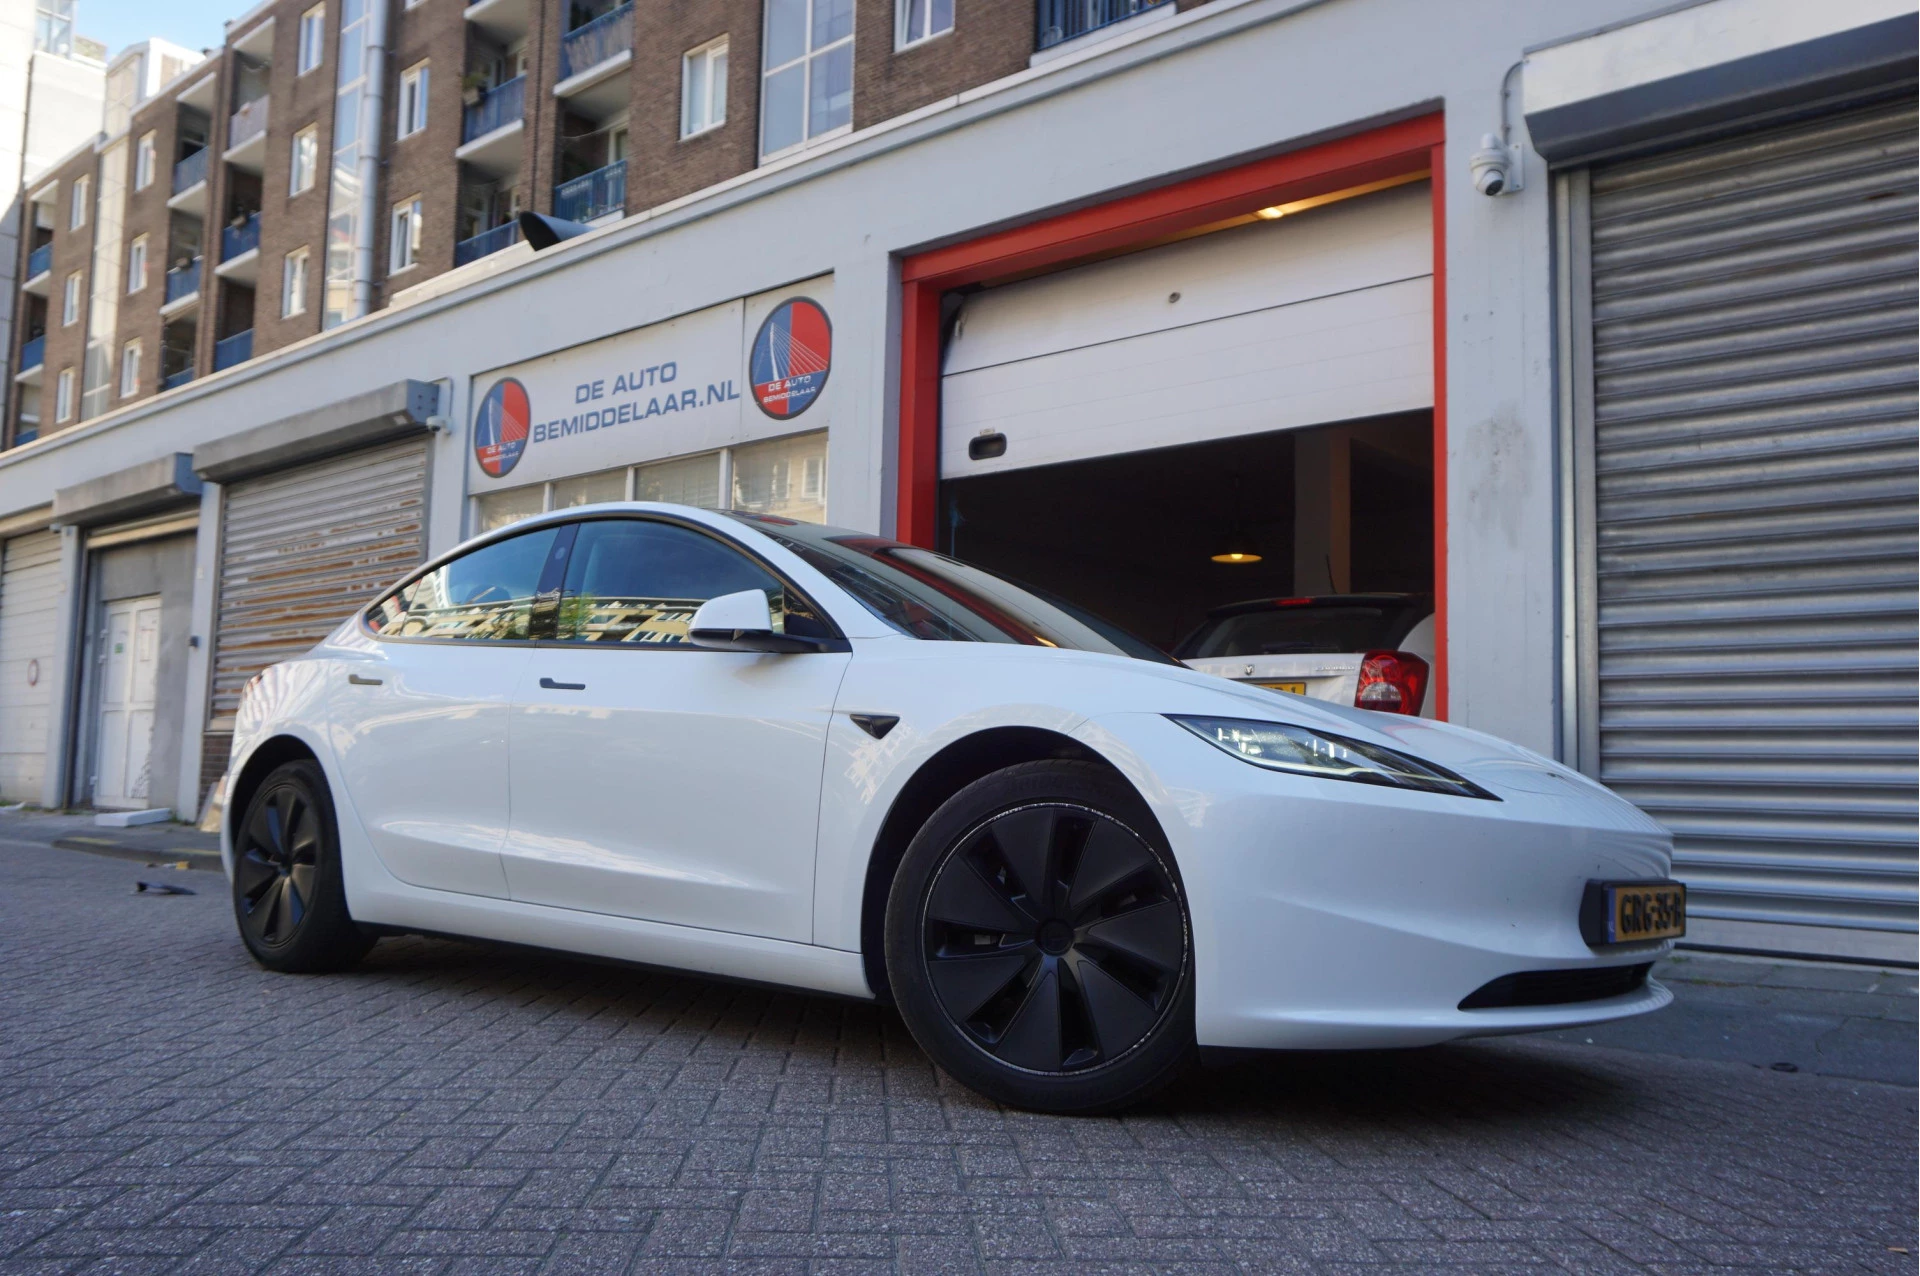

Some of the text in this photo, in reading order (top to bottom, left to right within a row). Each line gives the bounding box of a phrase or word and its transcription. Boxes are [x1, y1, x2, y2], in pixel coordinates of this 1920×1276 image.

[575, 361, 677, 404] DE AUTO
[763, 386, 816, 403] BEMIDDELAAR
[768, 375, 811, 392] DE AUTO
[533, 380, 740, 443] BEMIDDELAAR.NL
